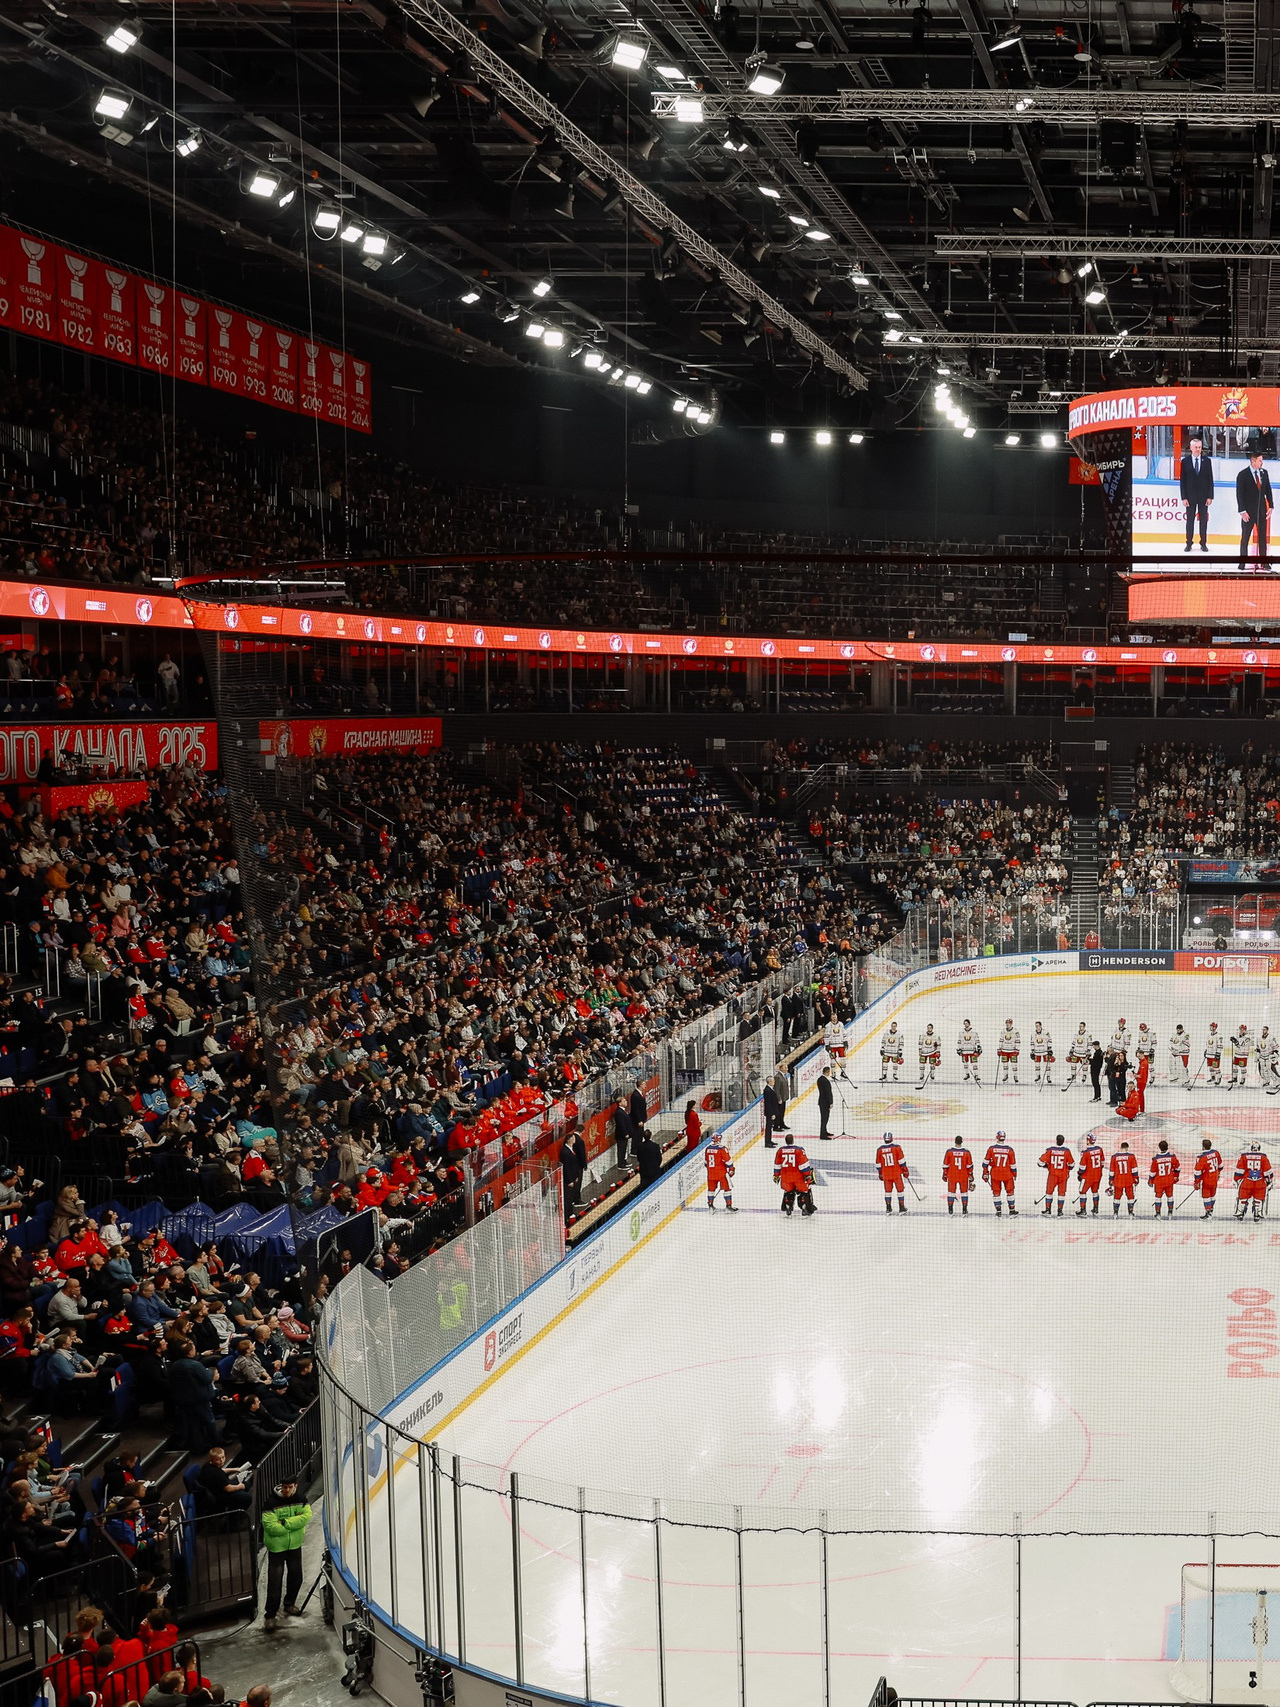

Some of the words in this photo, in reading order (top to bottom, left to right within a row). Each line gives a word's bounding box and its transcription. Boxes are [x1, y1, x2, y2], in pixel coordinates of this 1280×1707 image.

[20, 305, 50, 332] 1981
[62, 318, 94, 346] 1982
[104, 331, 132, 356] 1983
[142, 344, 169, 368] 1986
[179, 355, 204, 377] 1989
[212, 365, 237, 387] 1990
[243, 375, 266, 397] 1993
[272, 385, 294, 405] 2008
[301, 394, 323, 412] 2009
[327, 402, 347, 421] 2012
[1090, 398, 1137, 423] КАНАЛА
[1137, 396, 1177, 418] 2025
[1096, 459, 1125, 471] ИБИРЬ
[1108, 470, 1123, 503] АРЕНА
[344, 731, 387, 748] КРАСНАЯ
[387, 729, 422, 746] МАШИНА
[53, 727, 148, 777] КАНАЛА
[159, 726, 206, 769] 2025
[1103, 957, 1166, 965] HENDERSON
[946, 965, 977, 979] MACHINE
[708, 1155, 715, 1168] 8
[781, 1154, 796, 1167] 29
[882, 1153, 894, 1166] 10
[954, 1157, 962, 1170] 4
[994, 1154, 1008, 1167] 77
[1050, 1155, 1065, 1169] 45
[1091, 1155, 1101, 1168] 13
[1118, 1161, 1128, 1174] 11
[1207, 1158, 1218, 1173] 34
[1247, 1160, 1261, 1171] 99
[1157, 1162, 1172, 1176] 87
[498, 1313, 523, 1345] СПОРТ
[391, 1391, 443, 1442] ОРНИКЕЛЬ
